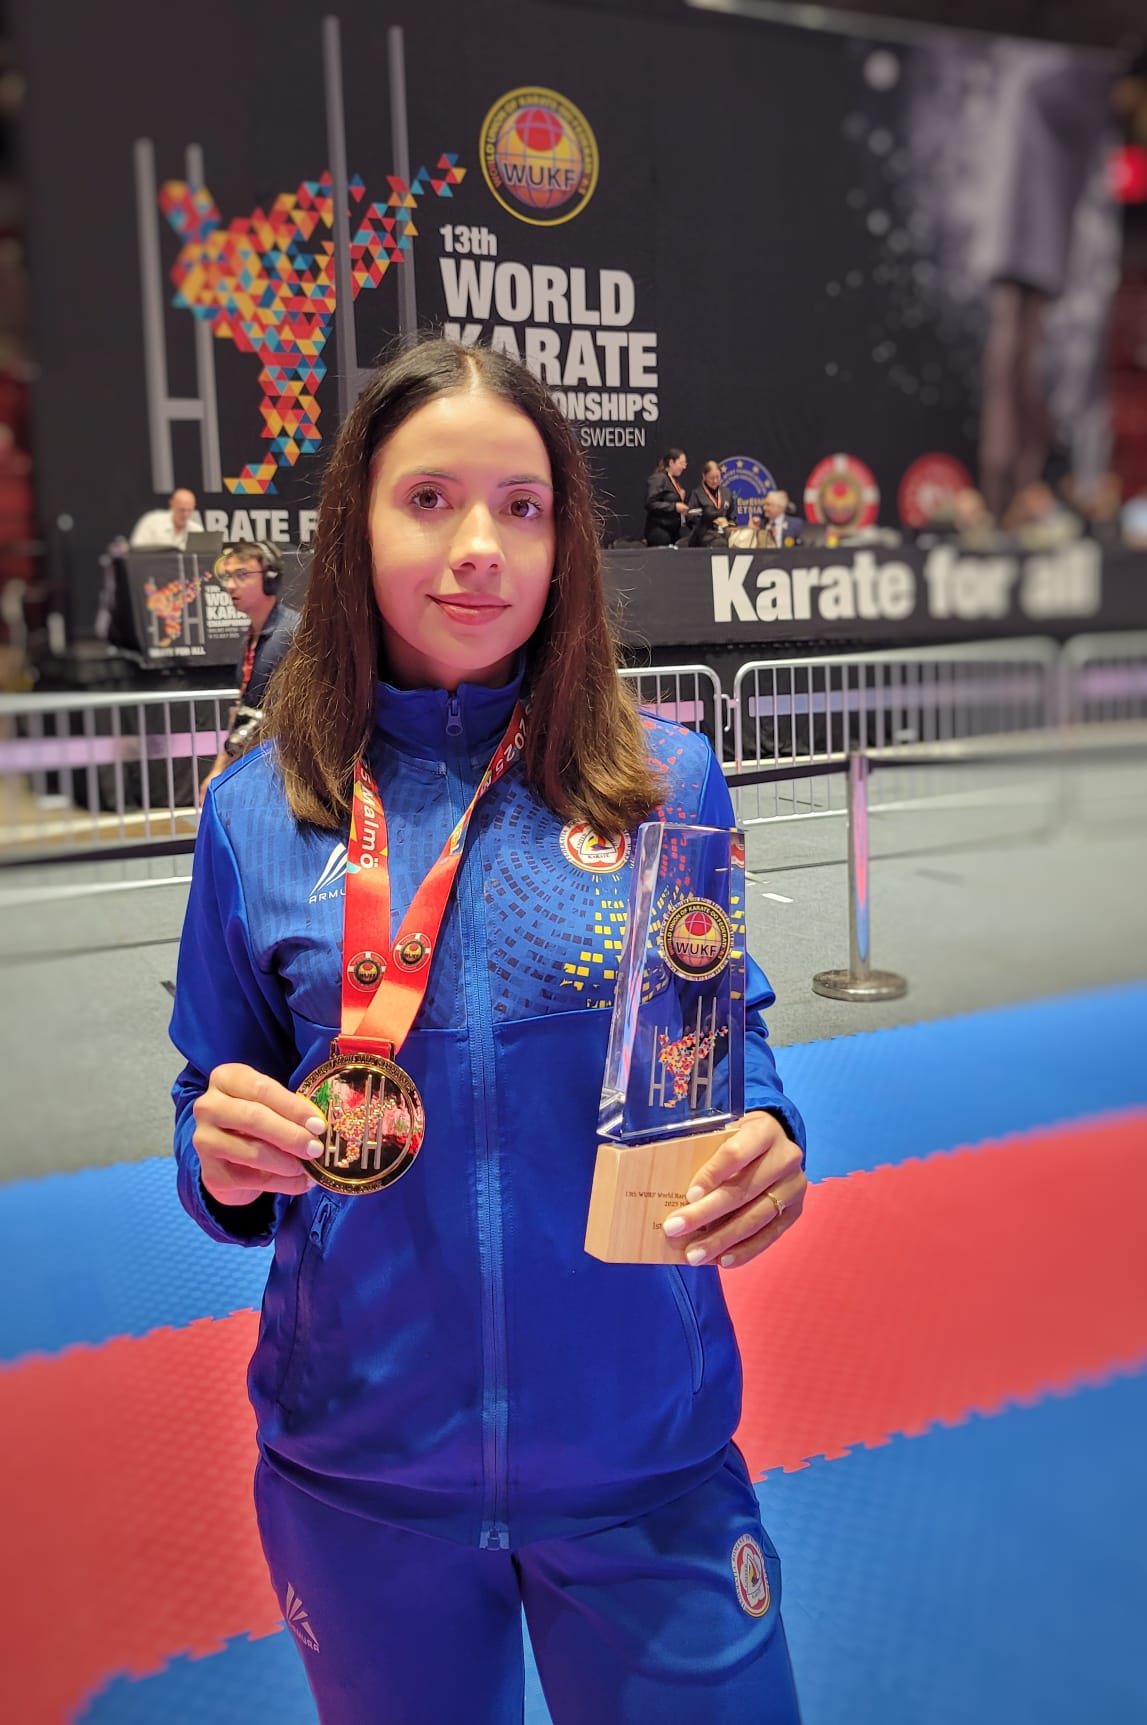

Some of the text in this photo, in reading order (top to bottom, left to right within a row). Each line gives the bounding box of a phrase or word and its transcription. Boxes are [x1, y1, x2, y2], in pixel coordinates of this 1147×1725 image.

[504, 162, 576, 188] WUKF
[439, 224, 497, 256] 13th
[439, 258, 636, 327] WORLD
[580, 427, 646, 447] SWEDEN
[191, 509, 290, 542] RATE
[710, 541, 1103, 623] Karate for all
[360, 784, 380, 868] Malmö
[309, 889, 346, 904] ARMU
[668, 912, 681, 931] UNION
[679, 907, 688, 916] OF
[676, 942, 718, 956] WUKF
